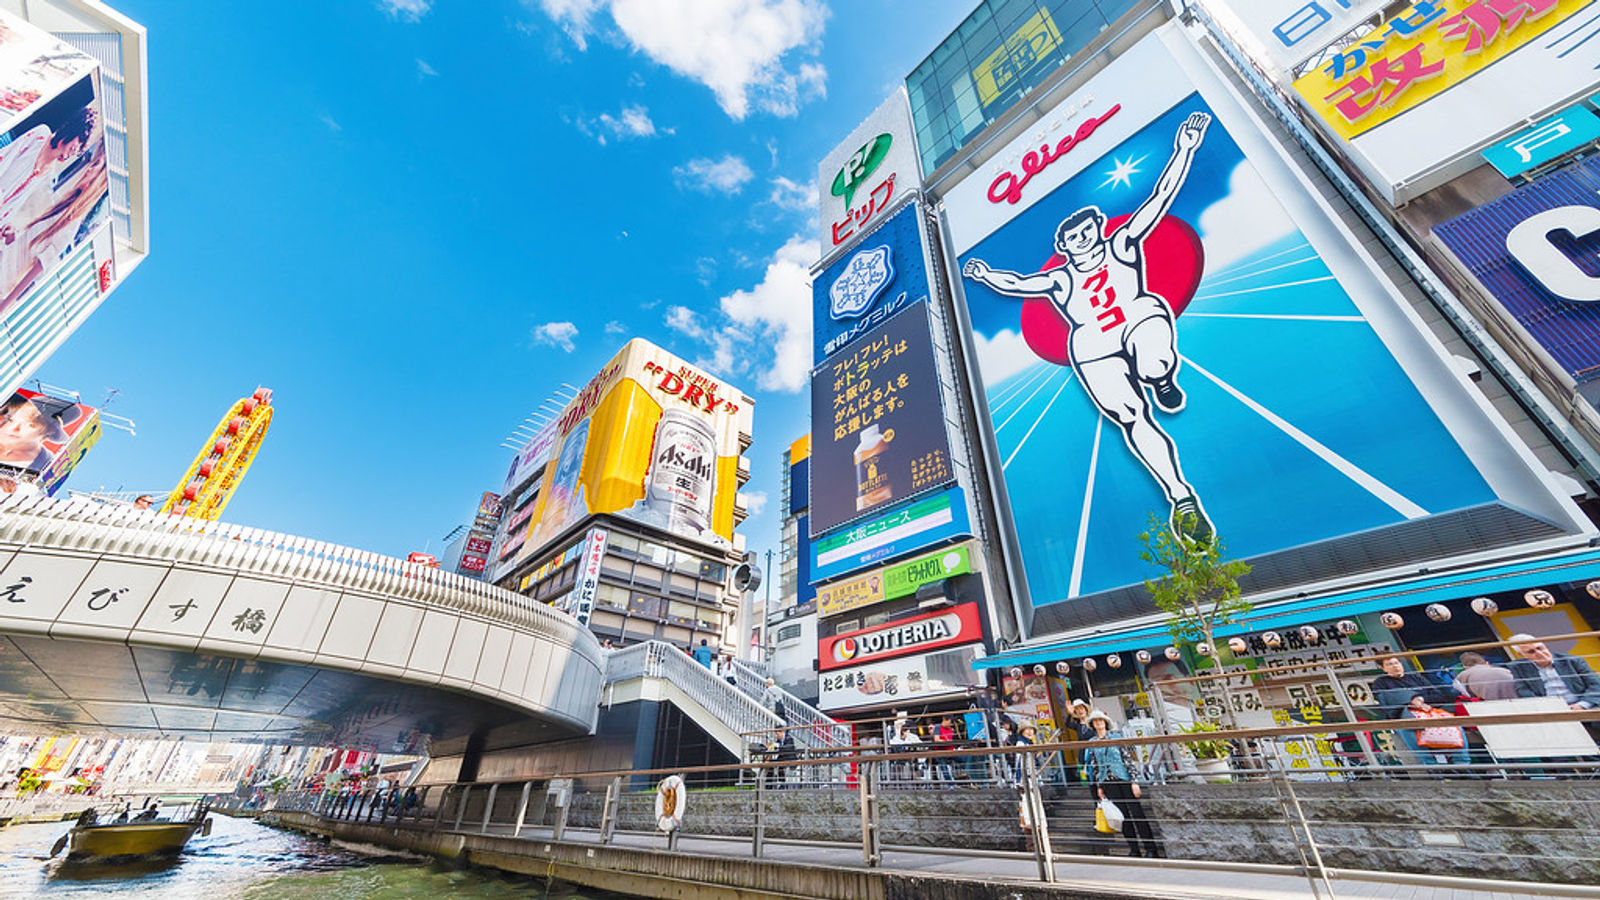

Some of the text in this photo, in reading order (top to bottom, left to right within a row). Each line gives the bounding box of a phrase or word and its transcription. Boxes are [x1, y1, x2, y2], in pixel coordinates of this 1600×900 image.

[987, 103, 1121, 204] Glico
[832, 172, 897, 246] ピップ
[1081, 264, 1126, 333] グリコ
[824, 291, 907, 355] 雪印メグミルク
[678, 366, 719, 393] SUPER
[833, 339, 908, 391] ボトラッテは
[833, 378, 872, 409] 大阪の
[834, 373, 910, 424] がんばる人を
[834, 397, 905, 441] 応援します。
[659, 444, 711, 481] Asahi
[676, 477, 692, 491] 生
[846, 510, 911, 544] 大阪ニュース
[0, 576, 266, 635] えびす橋
[860, 619, 950, 652] LOTTERIA
[1268, 646, 1391, 677] 店内大型T
[823, 671, 867, 693] たこ焼き
